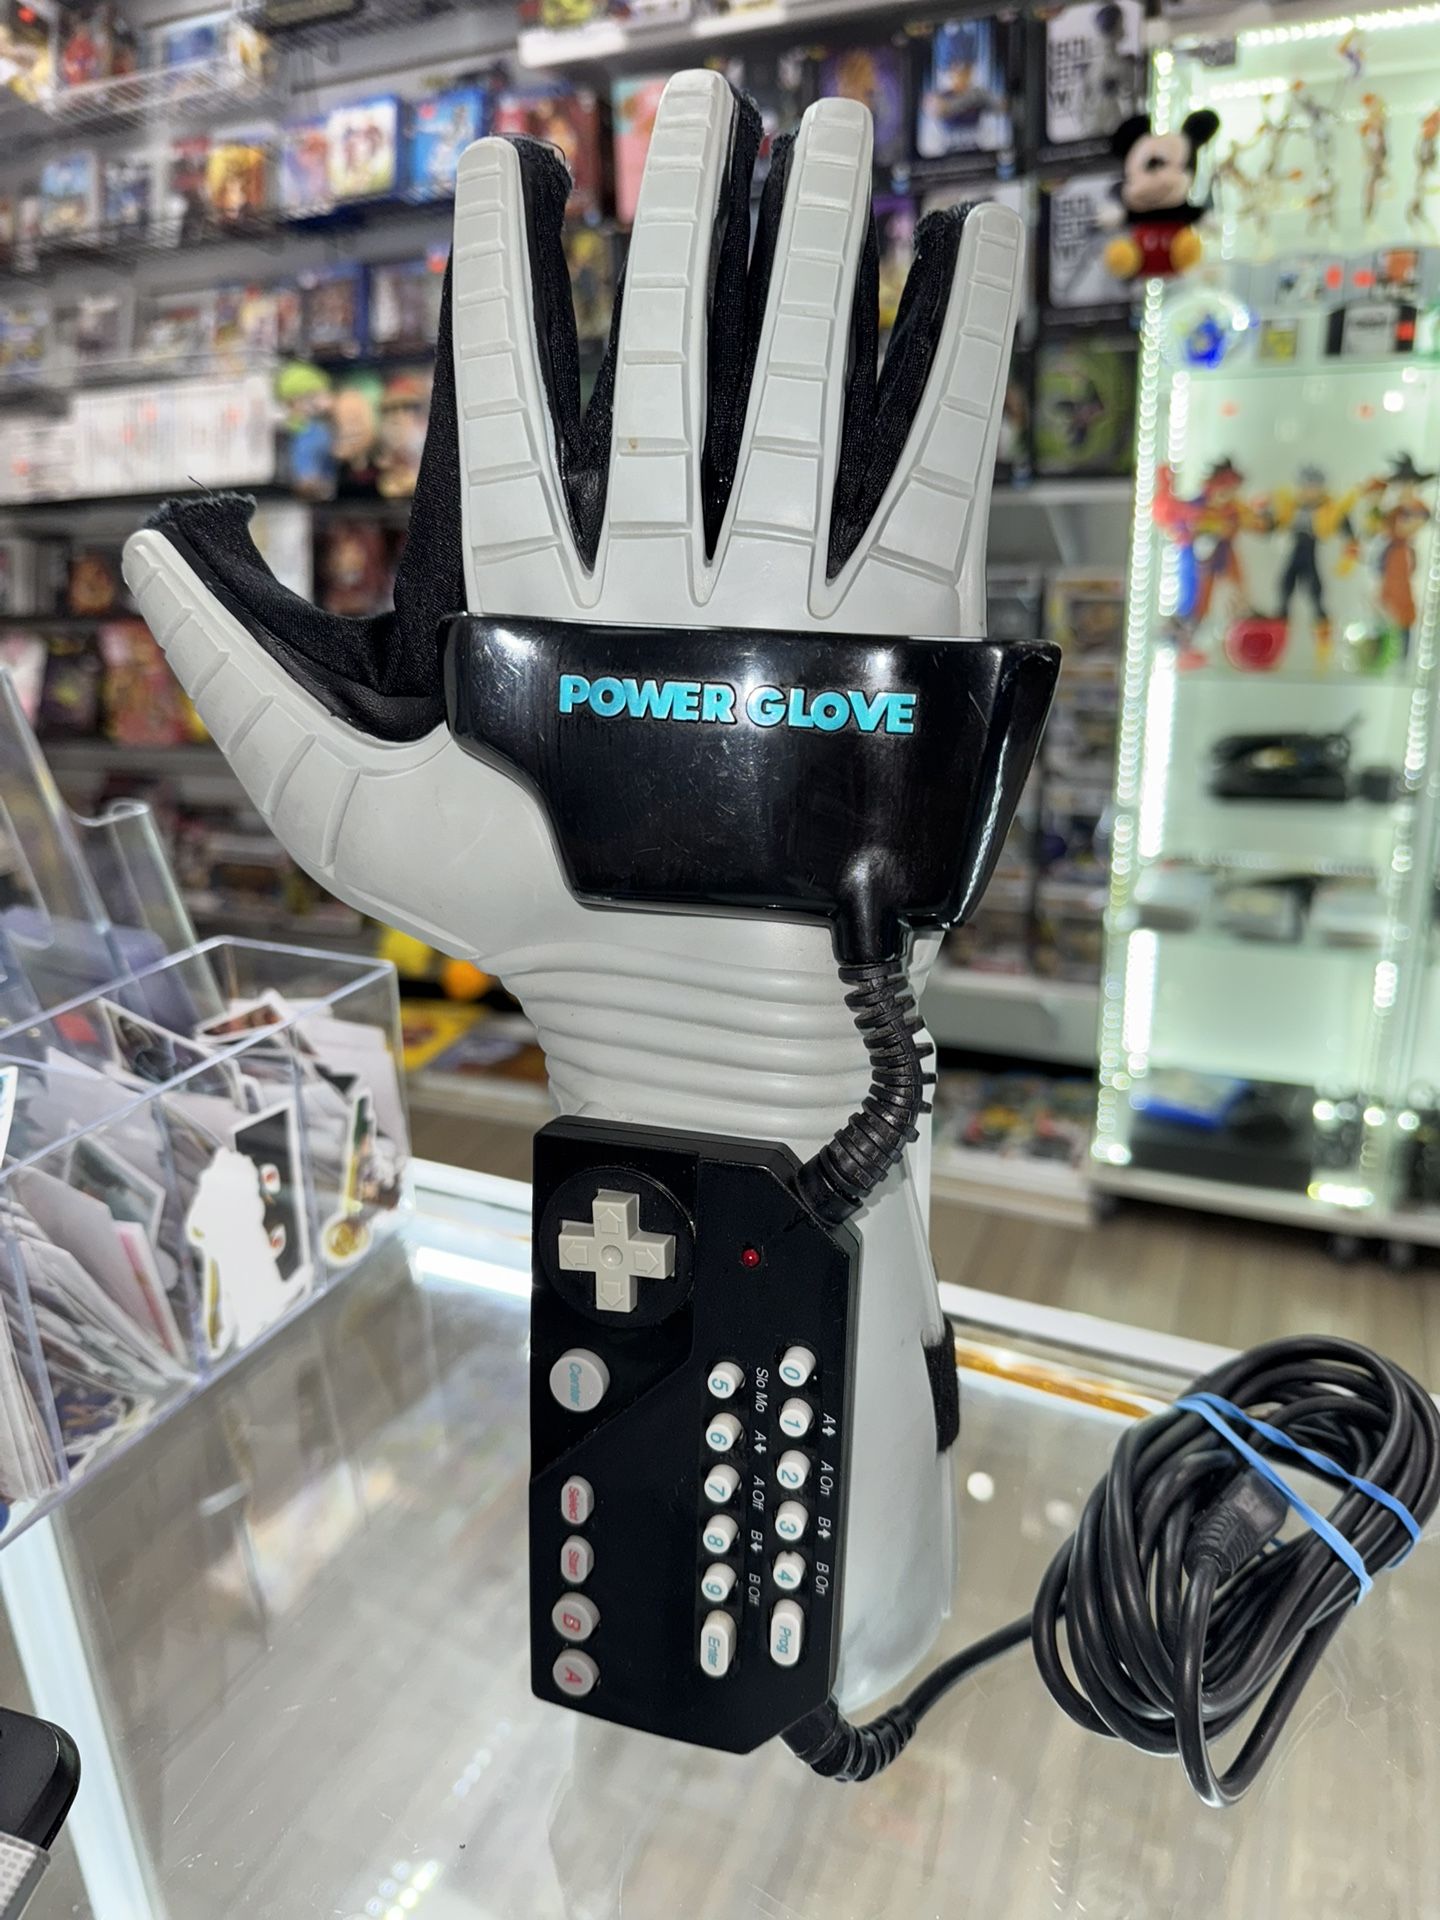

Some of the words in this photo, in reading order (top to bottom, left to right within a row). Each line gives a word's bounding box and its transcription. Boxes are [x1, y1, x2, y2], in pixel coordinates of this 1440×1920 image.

[559, 674, 736, 723] POWER
[746, 686, 917, 734] GLOVE
[755, 1368, 768, 1388] Slo
[783, 1367, 800, 1380] 0
[569, 1362, 582, 1407] Center
[712, 1378, 728, 1392] 5
[755, 1391, 768, 1413] Mo
[784, 1419, 801, 1428] 1
[822, 1413, 835, 1426] A
[710, 1432, 727, 1446] 6
[754, 1430, 765, 1443] A
[821, 1460, 833, 1473] A
[753, 1476, 765, 1487] A
[781, 1469, 799, 1483] 2
[708, 1484, 725, 1497] 7
[820, 1475, 833, 1495] On
[568, 1486, 580, 1521] Select
[752, 1489, 764, 1510] Off
[780, 1520, 796, 1534] 3
[818, 1516, 830, 1528] B
[707, 1534, 724, 1547] 8
[751, 1530, 762, 1542] B
[568, 1549, 580, 1576] Start
[817, 1562, 828, 1574] B
[748, 1573, 760, 1586] B
[777, 1569, 795, 1583] 4
[706, 1583, 722, 1595] 9
[815, 1575, 828, 1595] On
[747, 1586, 760, 1606] Off
[563, 1614, 581, 1632] B
[777, 1625, 792, 1653] Prog
[707, 1636, 720, 1668] Enter
[565, 1668, 583, 1684] A
